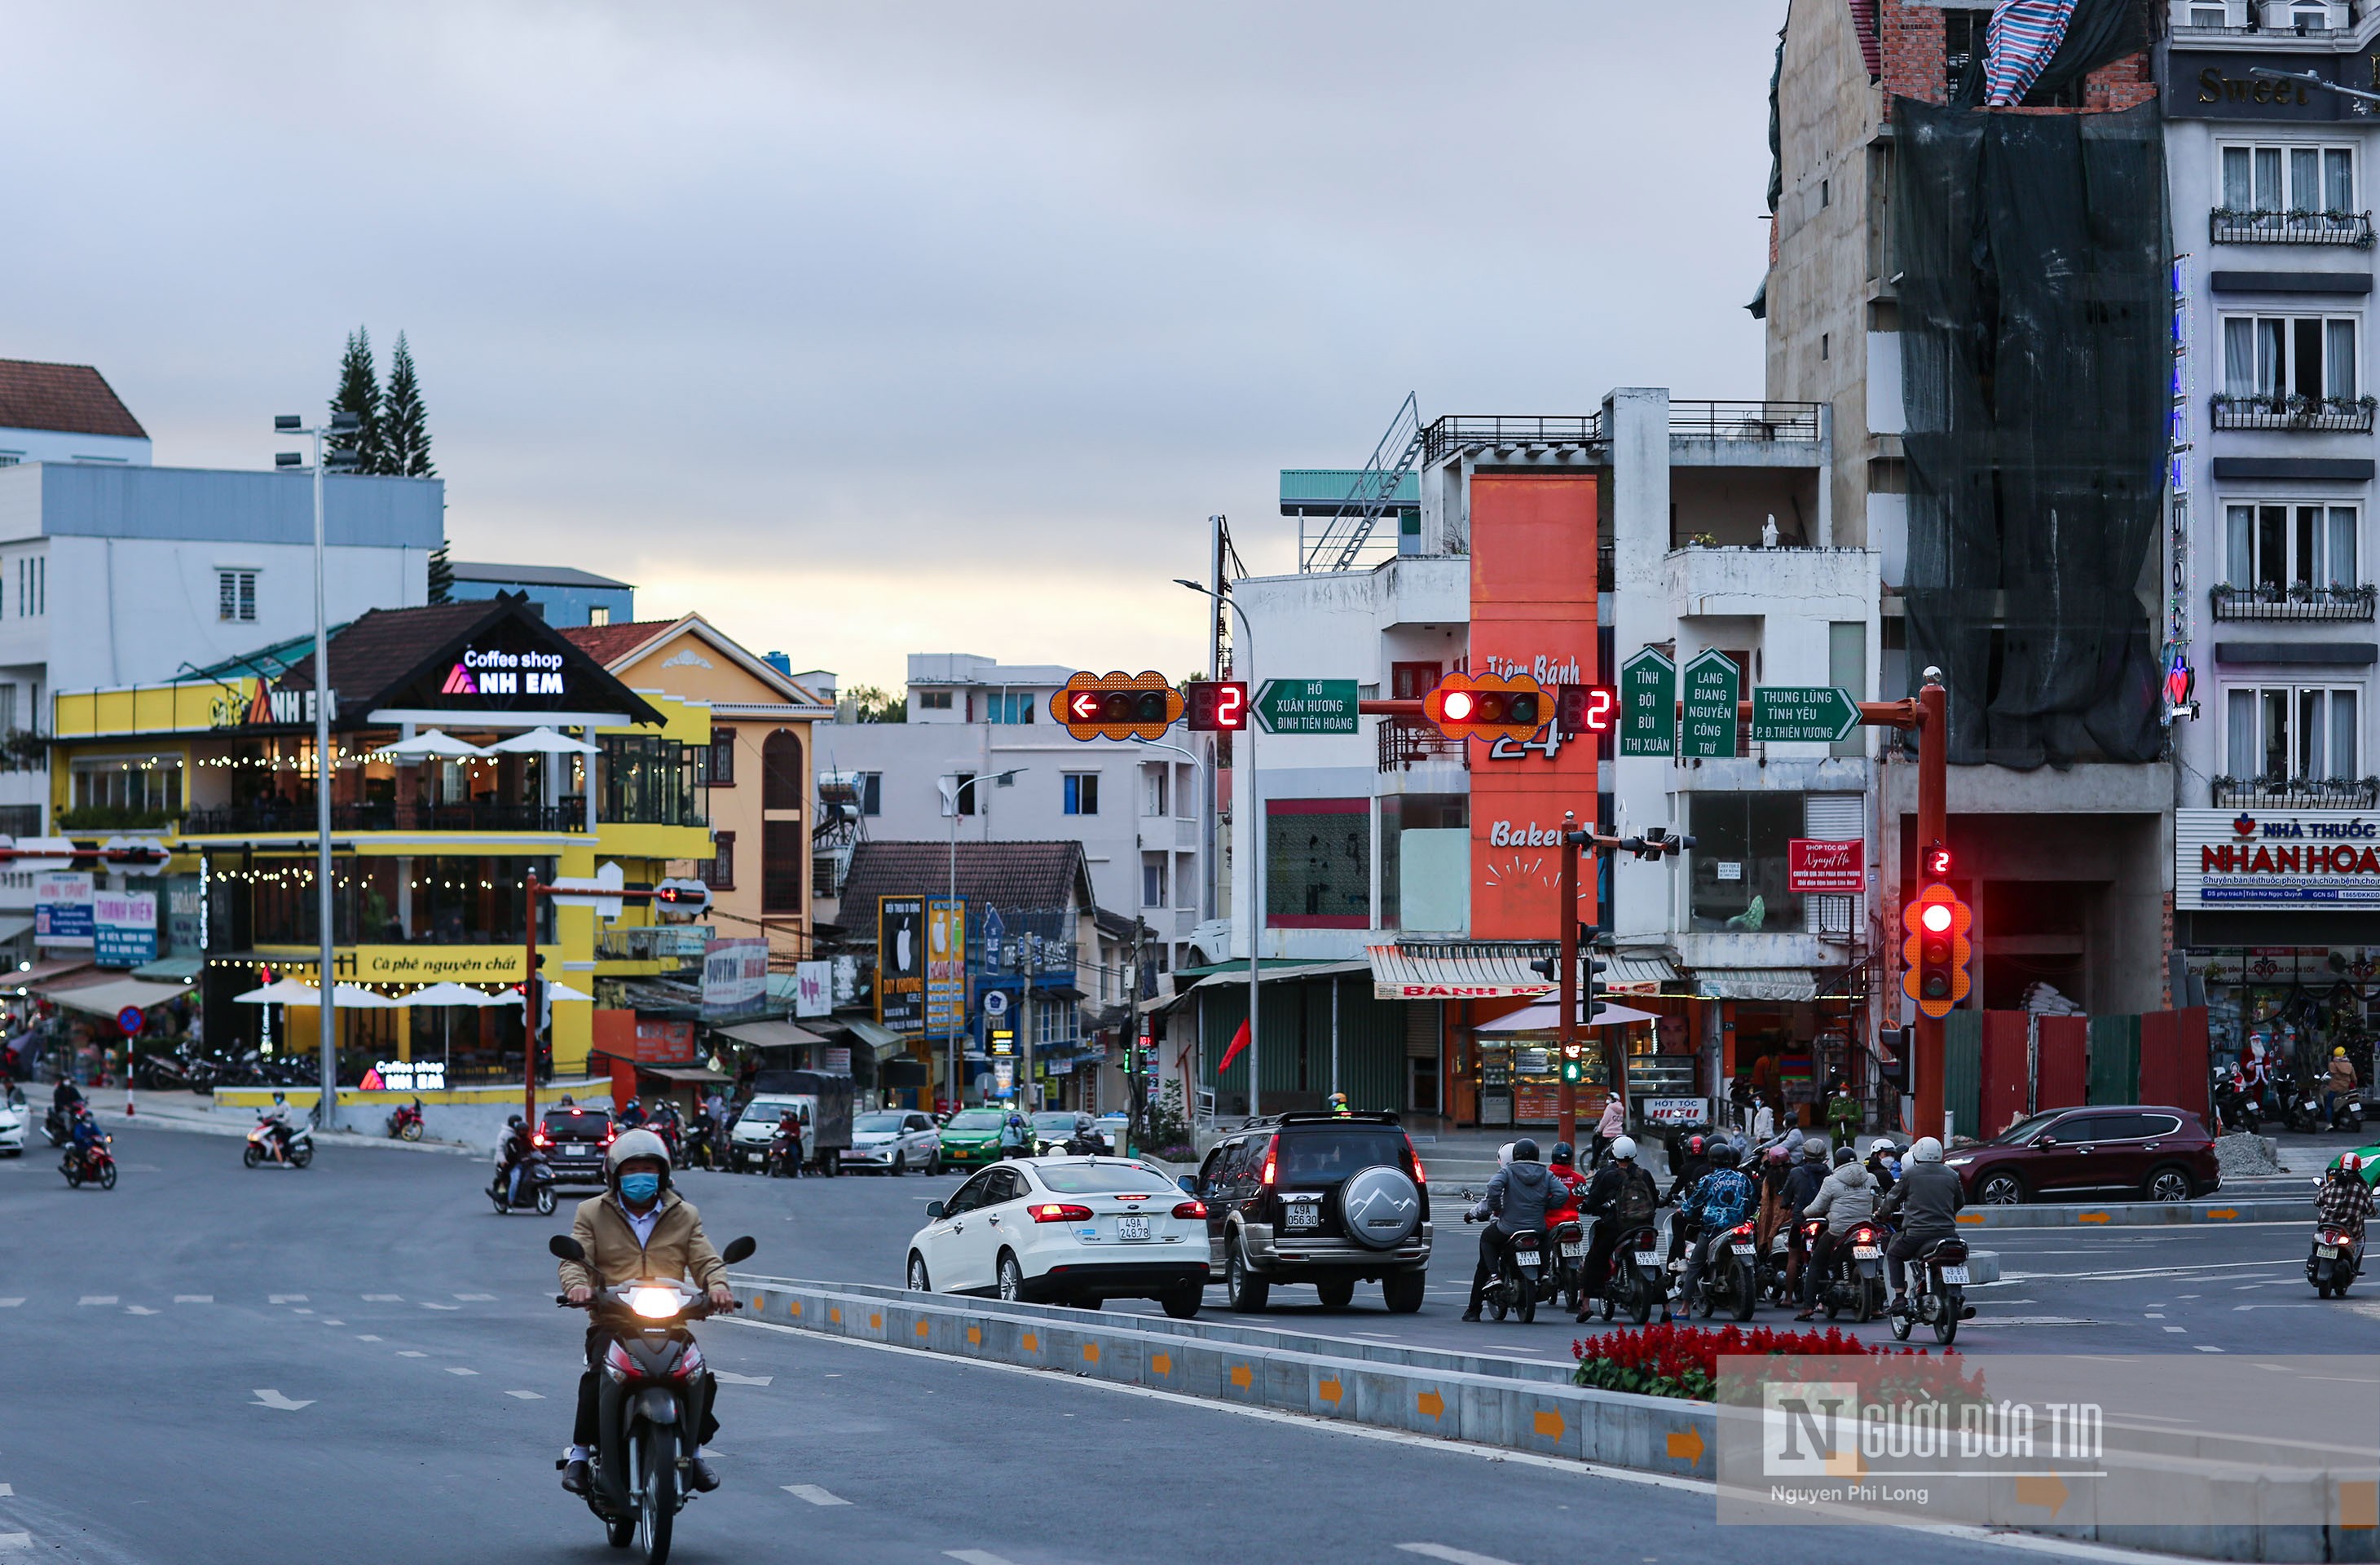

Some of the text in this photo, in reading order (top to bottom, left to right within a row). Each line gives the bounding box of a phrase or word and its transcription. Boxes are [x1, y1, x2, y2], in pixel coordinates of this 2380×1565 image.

[465, 650, 562, 671] Coffee shop
[1533, 655, 1580, 685] Bánh
[1636, 668, 1659, 684] TỈNH
[526, 672, 563, 694] EM
[1697, 672, 1723, 684] LANG
[1307, 680, 1323, 695] HỒ
[1638, 692, 1655, 708] ĐỘI
[1695, 689, 1726, 701] BIANG
[1763, 690, 1832, 703] THUNG LŨNG
[1218, 687, 1241, 725] 2
[1276, 698, 1343, 712] XUÂN HƯƠNG
[1587, 691, 1610, 729] 2
[1689, 703, 1731, 718] NGUYỄN
[1768, 706, 1817, 720] TÌNH YÊU
[1277, 714, 1353, 730] ĐINH TIÊN HOÀNG
[1638, 713, 1655, 729] BÙI
[1694, 723, 1721, 737] CÔNG
[1756, 727, 1763, 738] P.
[1802, 726, 1832, 738] VƯƠNG
[1625, 737, 1669, 752] THỊ XUÂN
[1699, 741, 1717, 754] TRỨ
[2263, 818, 2376, 838] NHÀ THUỐC
[1935, 853, 1949, 872] 2
[2202, 844, 2301, 873] NHAN
[2203, 876, 2232, 886] Chuyên
[2258, 875, 2280, 884] thuốc
[2341, 876, 2360, 886] bệnh
[2361, 876, 2375, 884] cho
[372, 954, 516, 973] Cà phê nguyên chất
[1403, 984, 1496, 996] BÁNH
[376, 1060, 445, 1073] Coffee shop
[1655, 1099, 1697, 1107] HỚT TÓC
[1294, 1205, 1311, 1215] 49A
[1126, 1218, 1142, 1228] 49A
[1288, 1215, 1317, 1225] 056.30
[1120, 1228, 1149, 1238] 248.78
